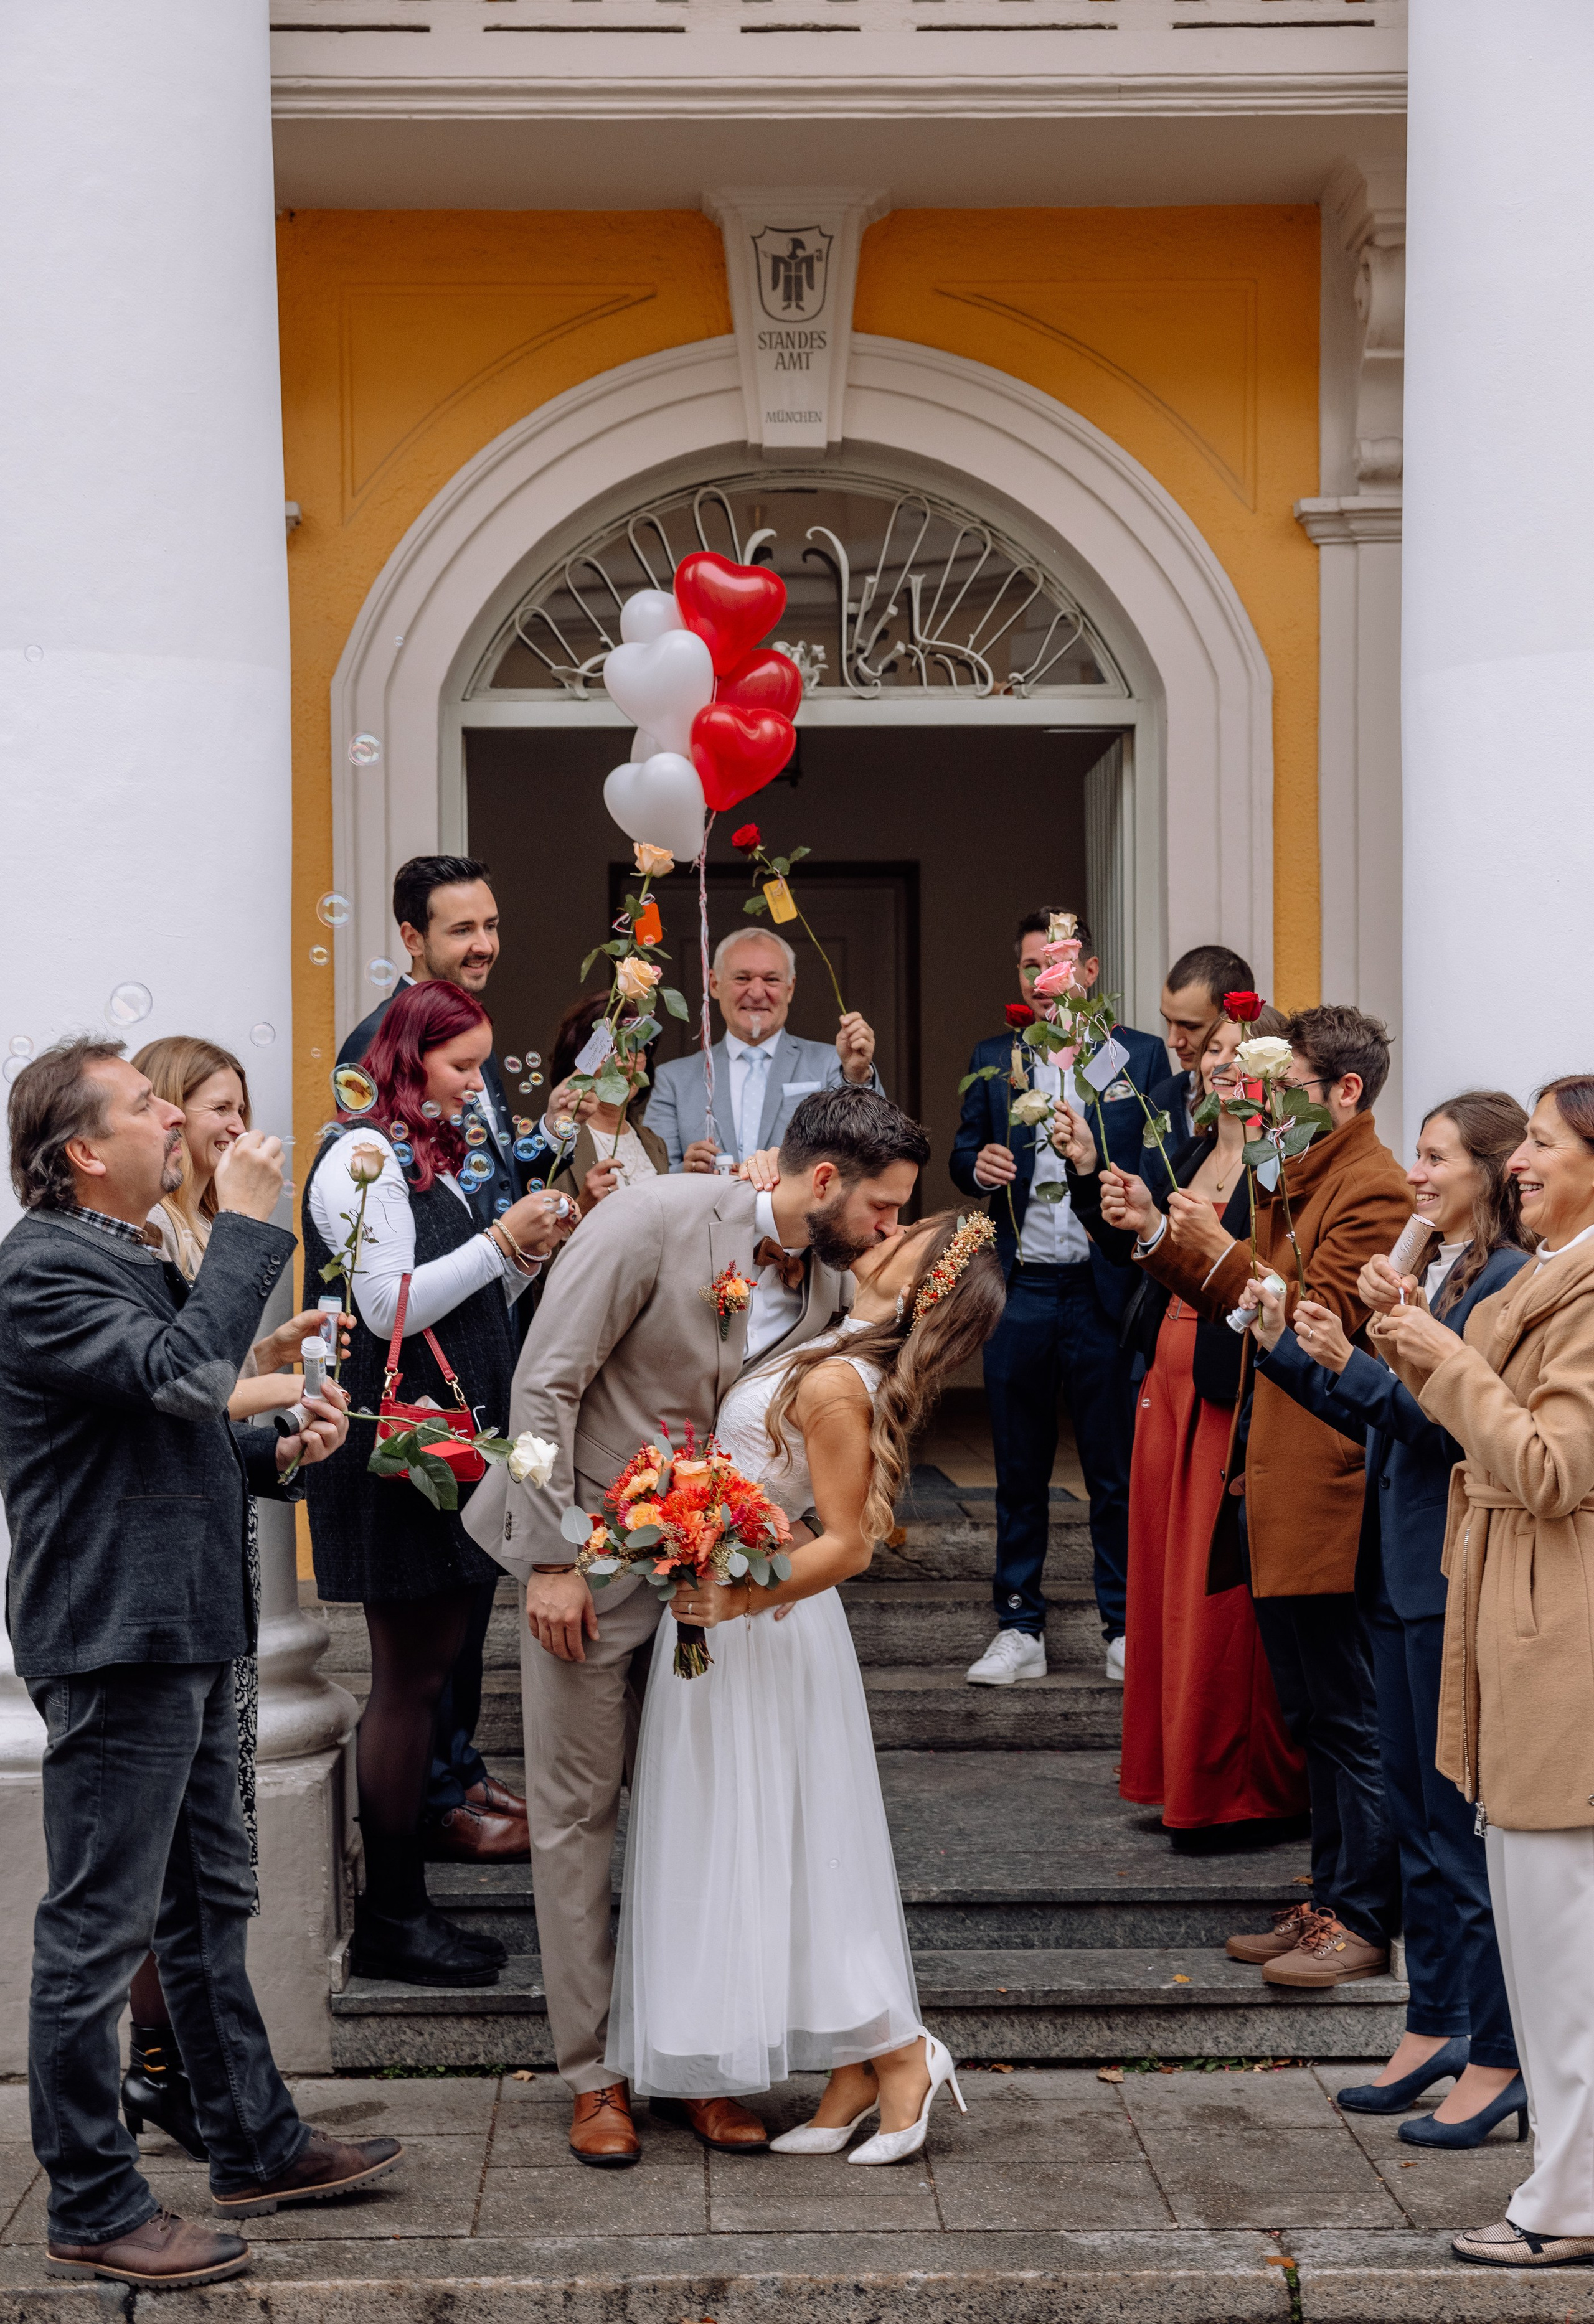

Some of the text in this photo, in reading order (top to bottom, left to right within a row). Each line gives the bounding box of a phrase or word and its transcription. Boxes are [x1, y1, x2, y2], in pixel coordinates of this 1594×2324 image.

[758, 331, 827, 350] STANDES
[775, 352, 814, 370] AMT
[766, 410, 822, 423] MÜNCHEN
[1397, 1230, 1417, 1262] Just
